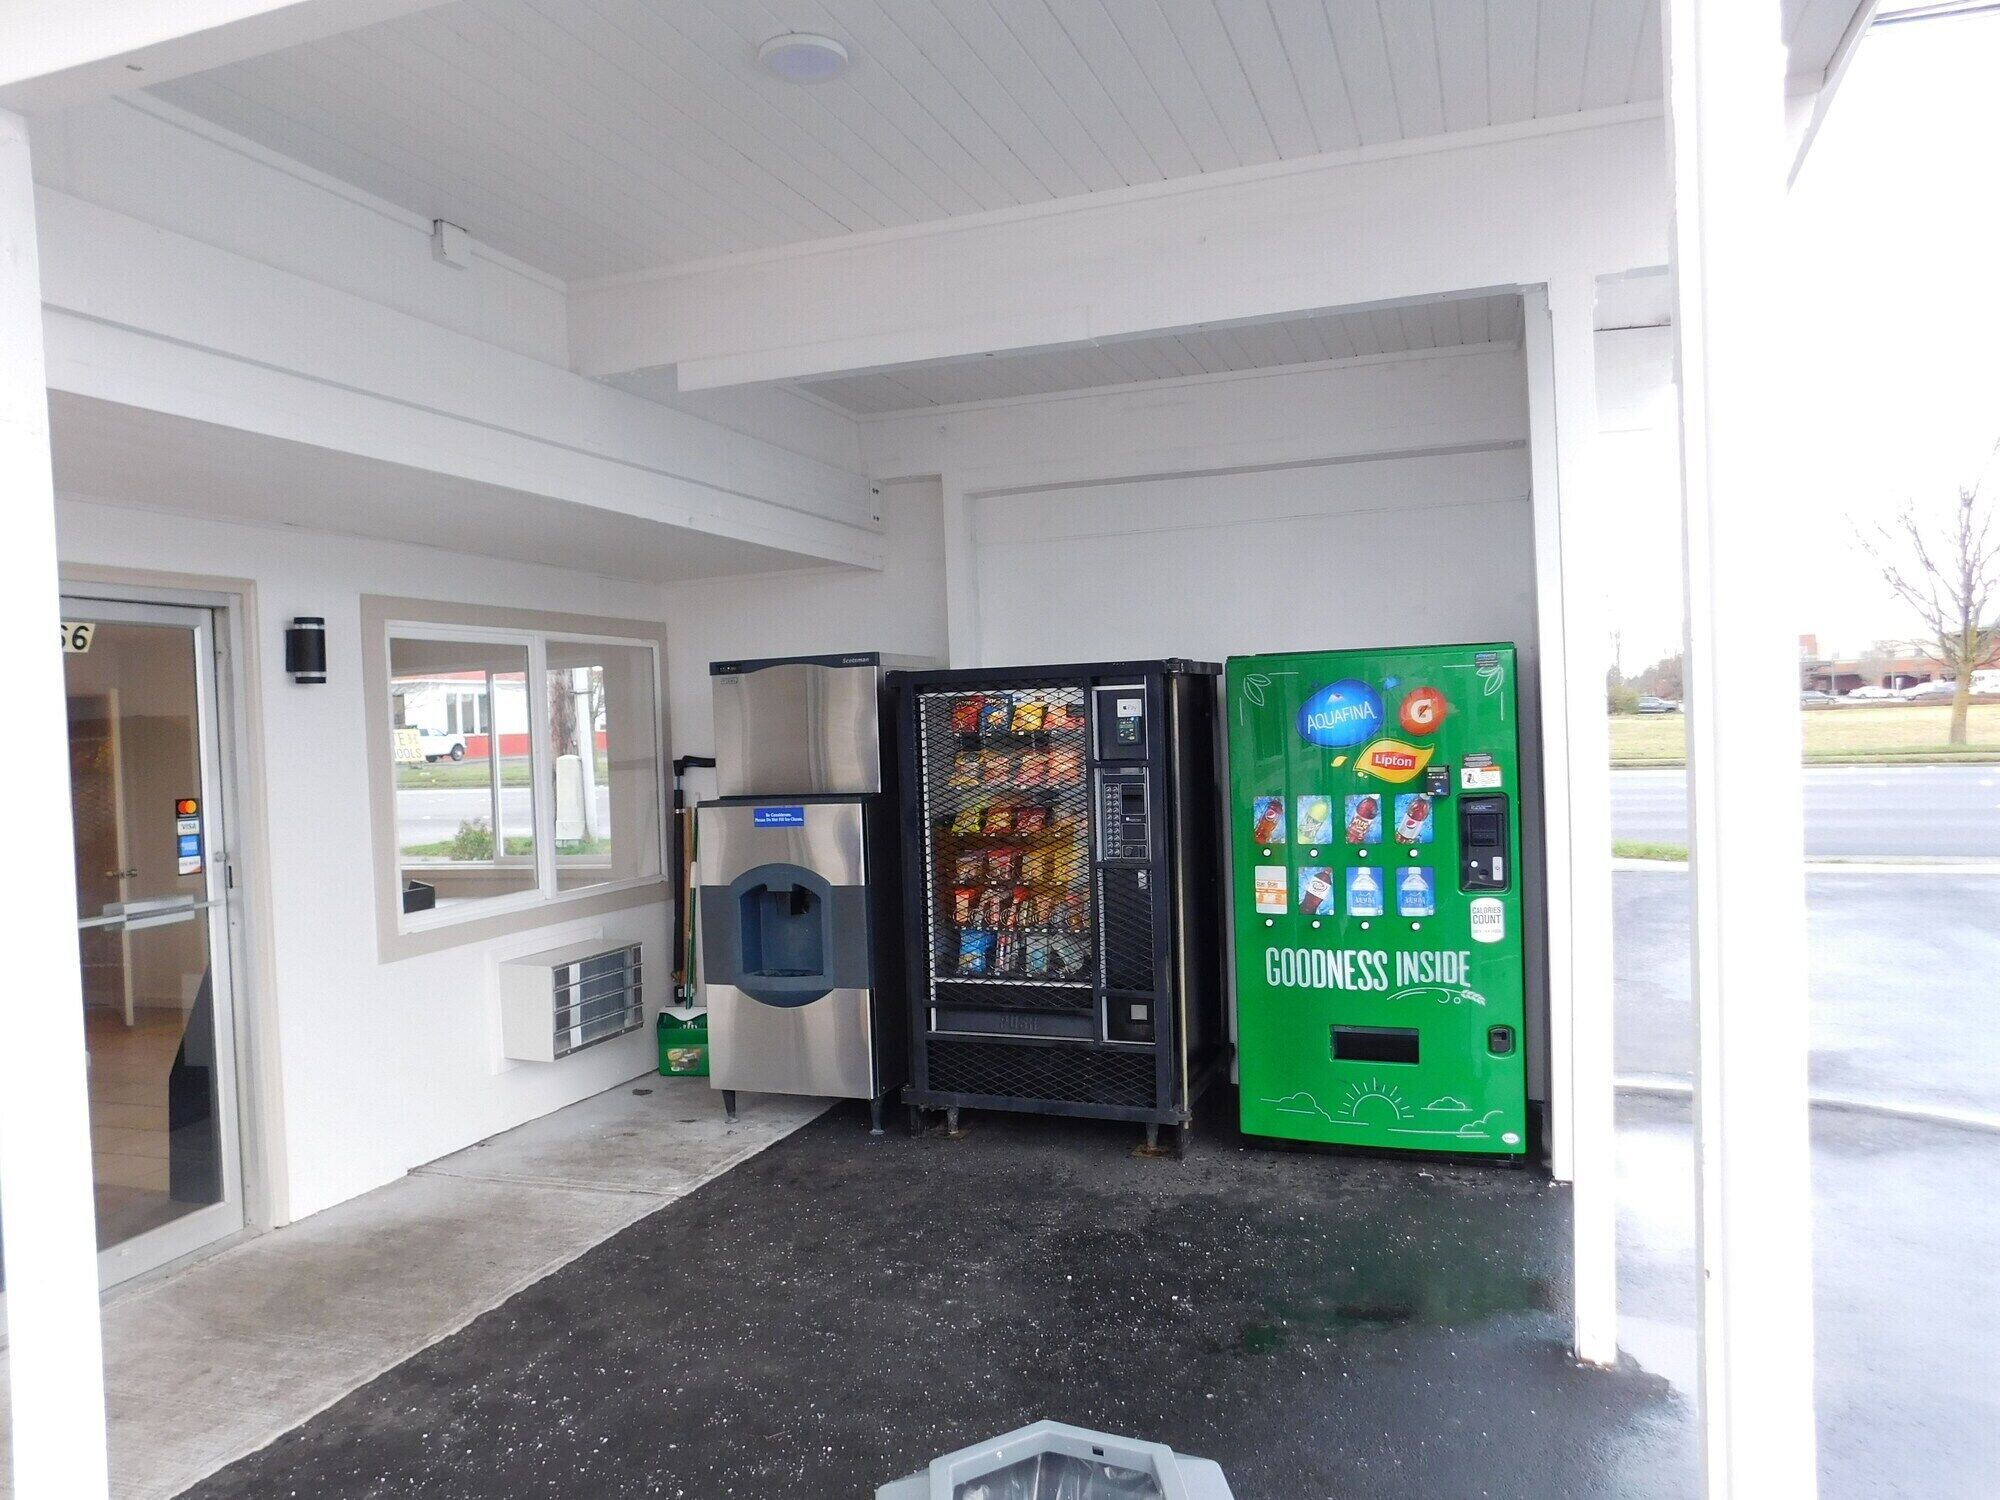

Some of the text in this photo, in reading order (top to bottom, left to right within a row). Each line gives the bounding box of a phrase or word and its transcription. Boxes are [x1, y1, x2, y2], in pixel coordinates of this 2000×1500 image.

[1307, 701, 1378, 735] AQUAFINA
[1410, 699, 1433, 724] G
[1375, 754, 1413, 767] Lipton
[1472, 906, 1502, 914] CALORIES
[1472, 914, 1502, 925] COUNT
[1265, 947, 1471, 991] GOODNESS INSIDE
